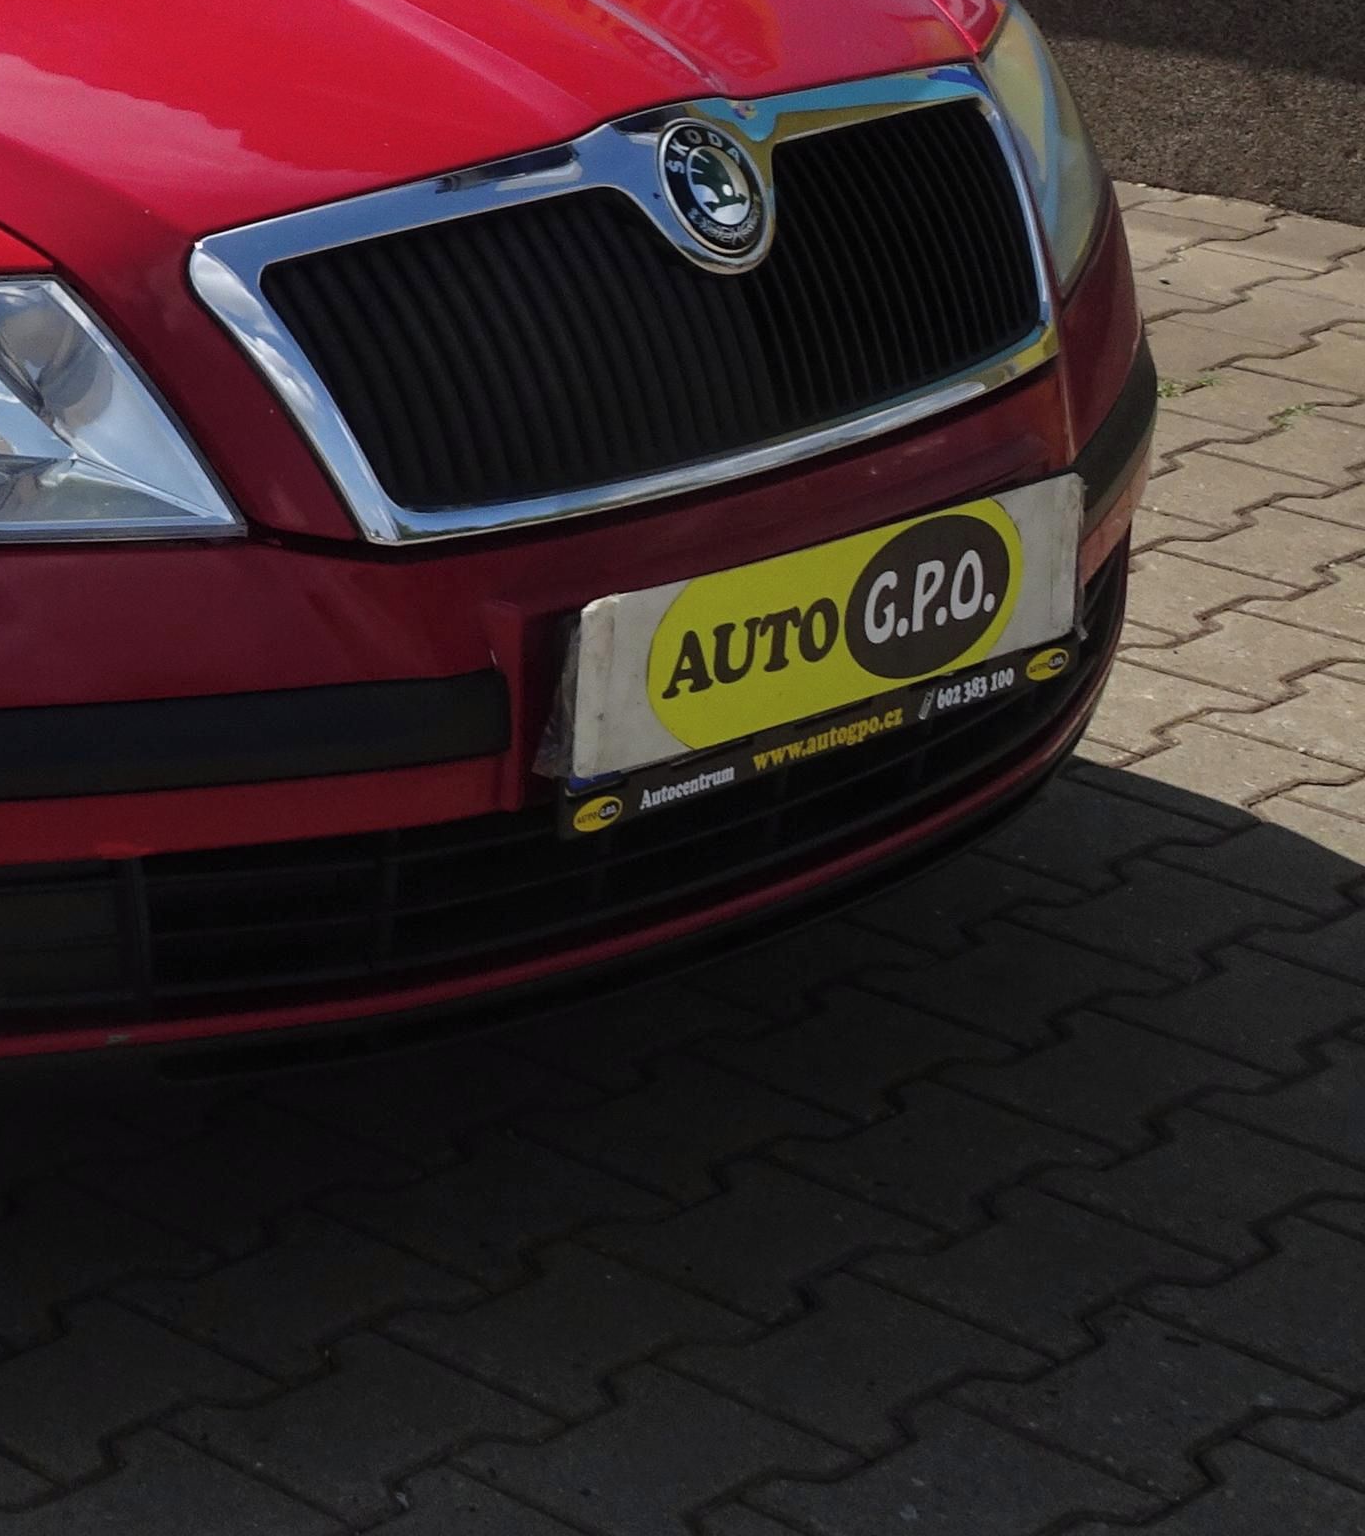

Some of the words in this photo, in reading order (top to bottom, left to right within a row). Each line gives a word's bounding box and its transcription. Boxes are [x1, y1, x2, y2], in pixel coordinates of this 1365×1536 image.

[661, 596, 840, 700] AUTO
[864, 549, 996, 645] G.P.O.
[638, 765, 736, 811] Autocentrum
[752, 706, 904, 771] www.autogpo.cz
[936, 685, 962, 710] 602
[989, 667, 1015, 692] 100
